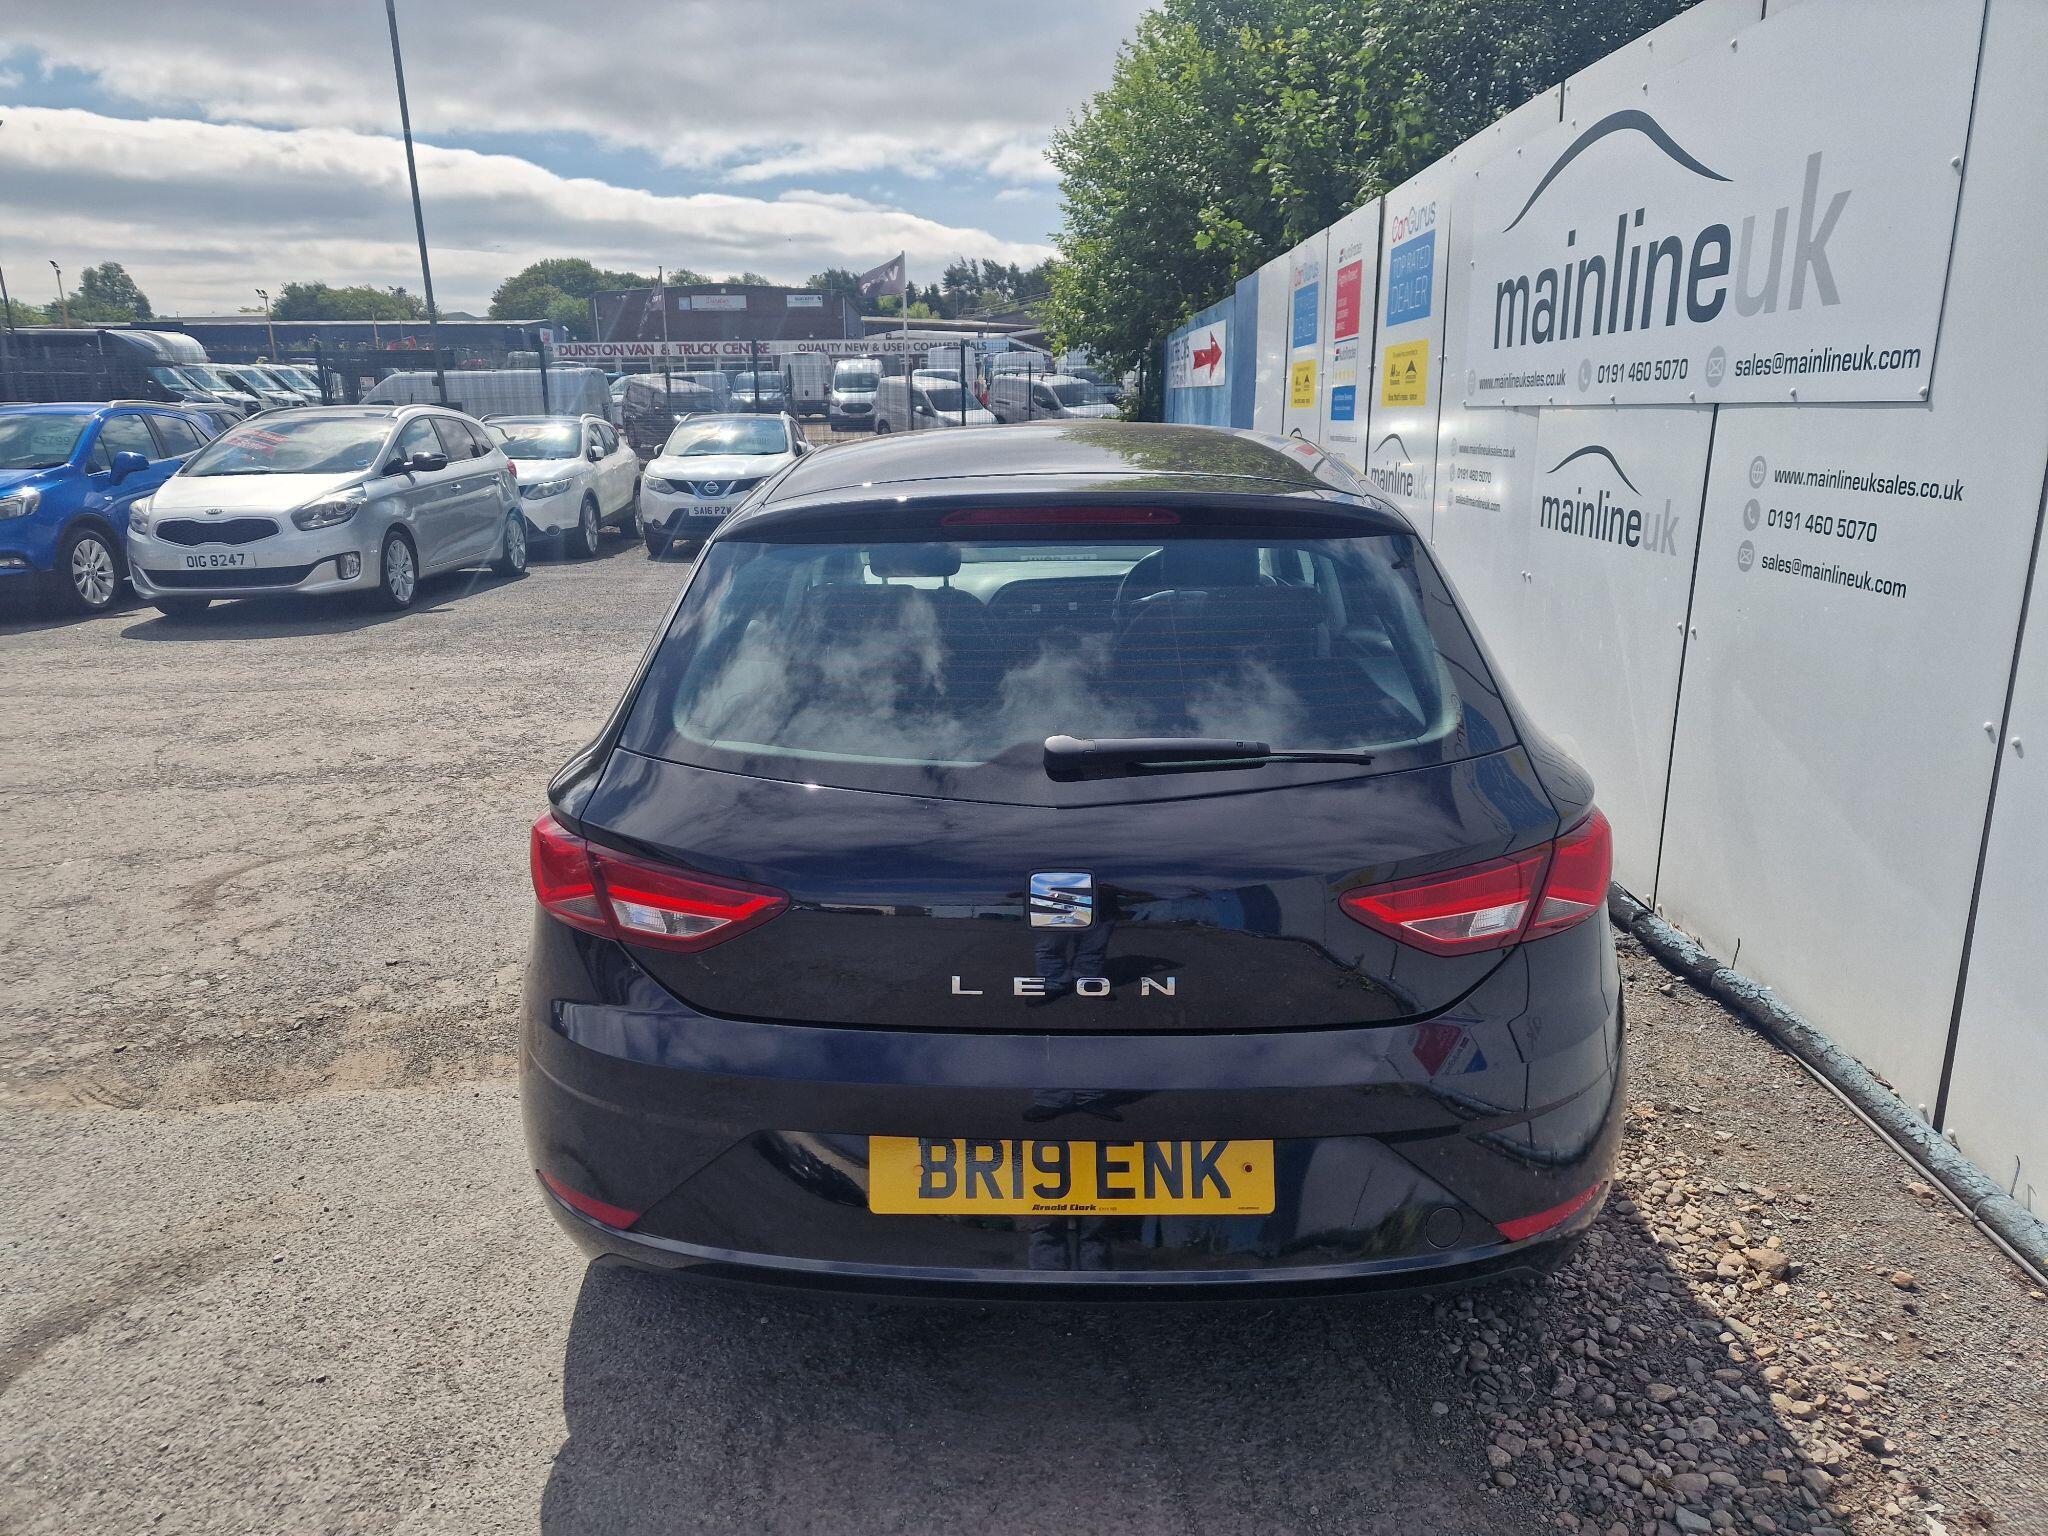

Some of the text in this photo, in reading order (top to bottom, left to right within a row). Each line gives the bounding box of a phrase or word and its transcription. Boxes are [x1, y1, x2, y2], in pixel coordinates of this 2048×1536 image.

[1391, 201, 1436, 243] CarGurus
[1392, 245, 1431, 279] TOP RATED
[1493, 151, 1852, 349] mainlineuk
[1391, 275, 1428, 315] DEALER
[559, 344, 623, 356] DUNSTON
[624, 344, 654, 356] VAN
[661, 345, 670, 355] &
[676, 343, 720, 355] TRUCK
[797, 343, 841, 352] QUALITY
[844, 343, 869, 351] NEW
[872, 343, 879, 351] &
[883, 343, 909, 351] USED
[1735, 344, 1921, 377] sales@mainlineuk.com
[1479, 368, 1567, 390] www.mainlineuksales.co.uk
[1598, 358, 1689, 384] 0191 460 5070
[1371, 461, 1428, 500] mainlineuk
[1774, 469, 1965, 501] www.mainlineuksales.co.uk
[693, 506, 713, 515] SA16
[1540, 487, 1680, 556] mainlineuk
[1767, 508, 1878, 543] 0191 460 5070
[186, 553, 246, 568] OIG 8247
[1761, 554, 1907, 599] sales@mainlineuk.com
[952, 976, 1176, 996] LEON
[918, 1138, 1231, 1199] BR19 ENK
[1032, 1203, 1067, 1211] Arnold
[1069, 1203, 1097, 1211] Clark
